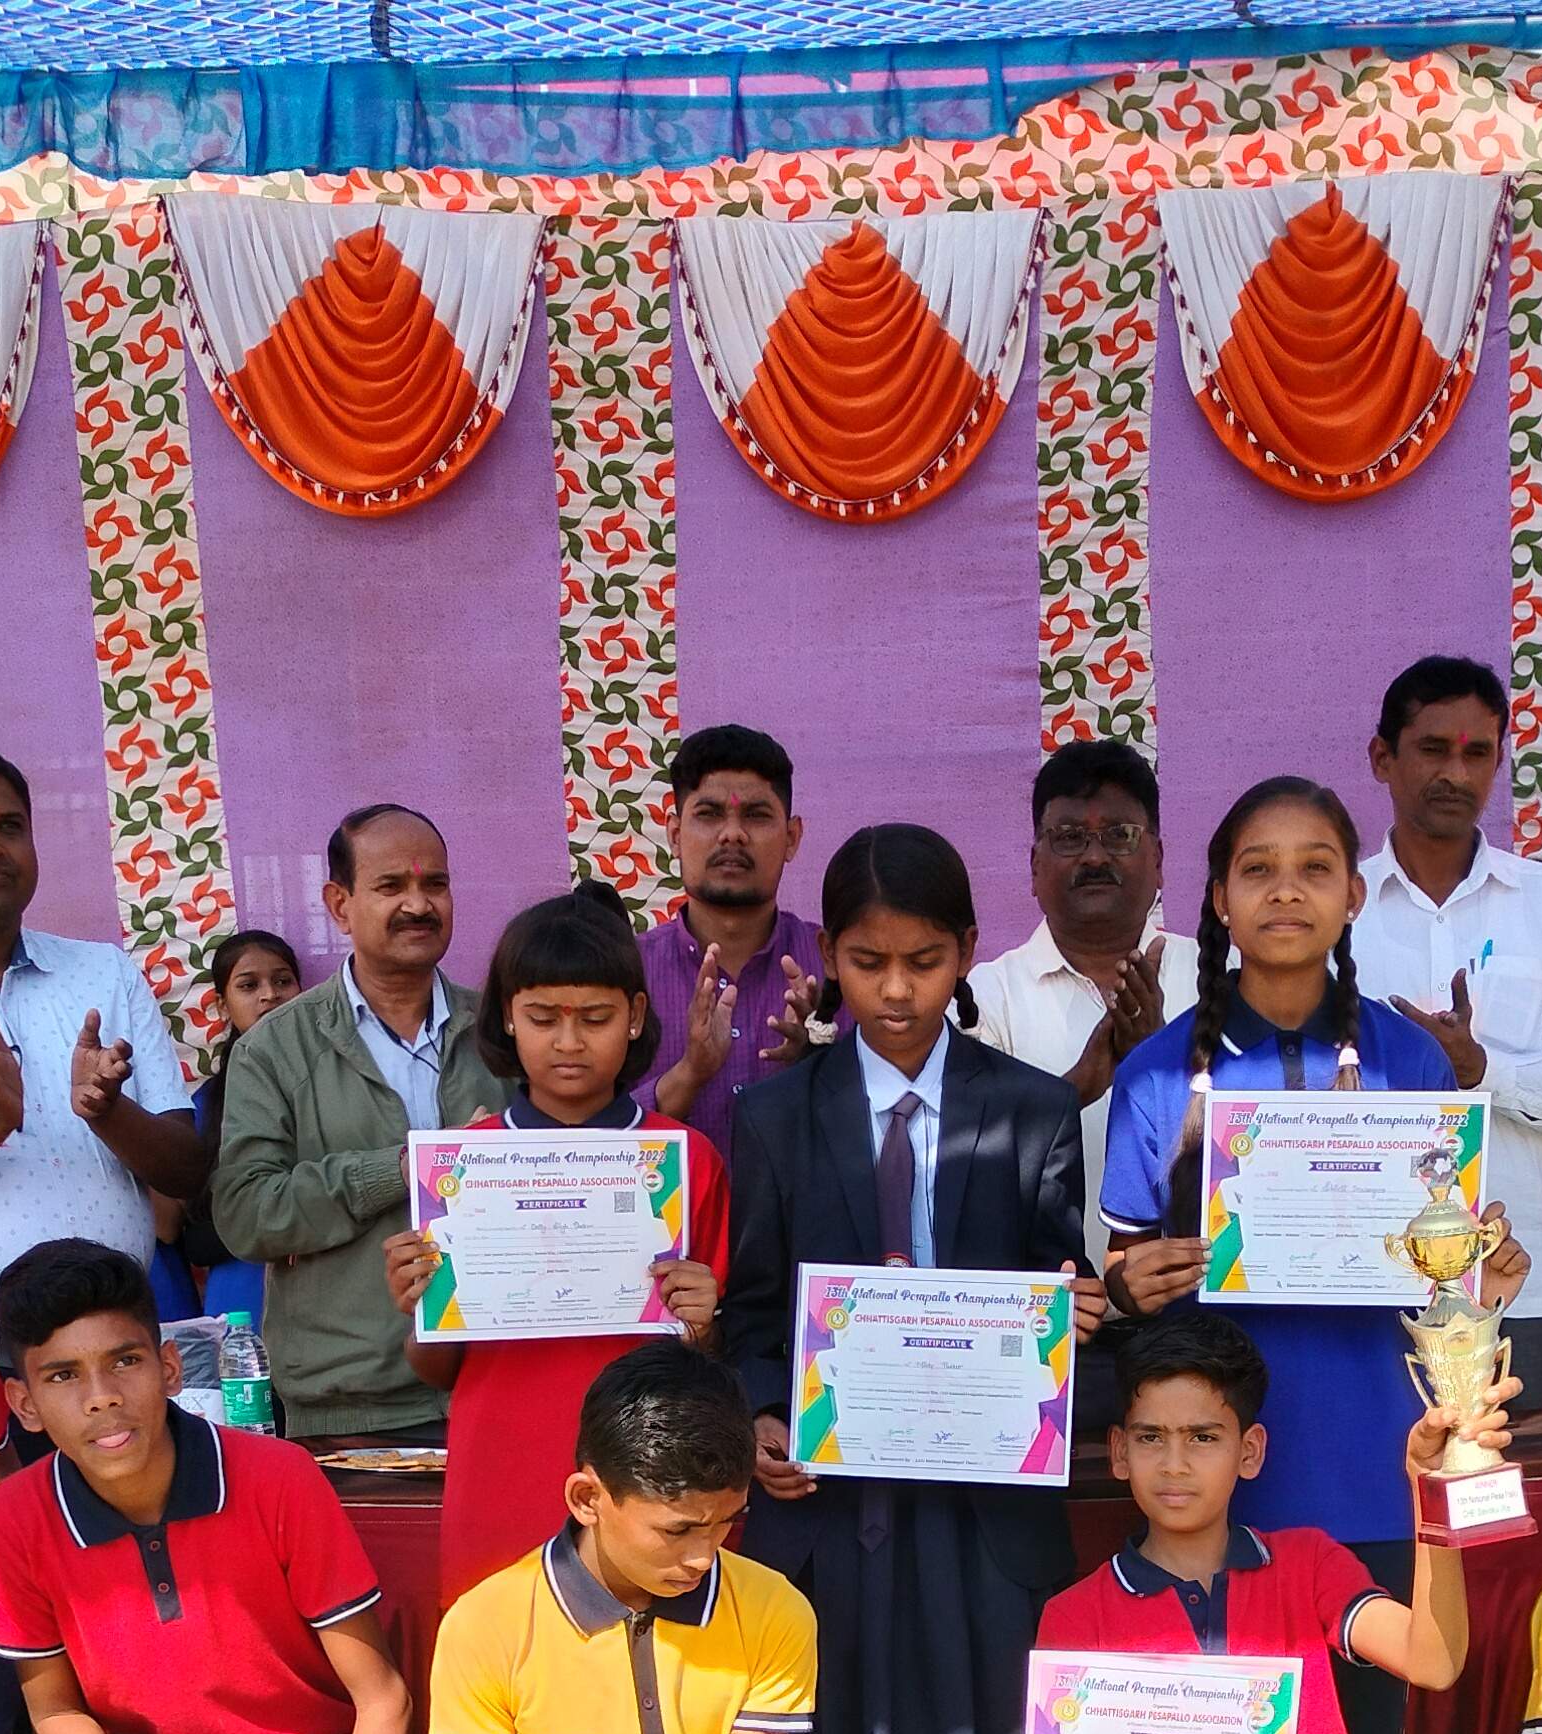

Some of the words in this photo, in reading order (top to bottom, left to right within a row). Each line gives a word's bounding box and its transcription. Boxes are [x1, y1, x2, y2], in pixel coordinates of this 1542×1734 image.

[1229, 1112, 1252, 1125] 13th
[1256, 1113, 1303, 1125] National
[1307, 1113, 1358, 1128] Pesapallo
[1362, 1113, 1435, 1128] Championship
[1439, 1114, 1467, 1126] 2022
[1259, 1139, 1325, 1149] CHHATTISGARH
[1327, 1140, 1374, 1149] PESAPALLO
[1377, 1141, 1435, 1150] ASSOCIATION
[433, 1153, 457, 1166] 13th
[460, 1153, 508, 1165] National
[510, 1152, 561, 1167] Pesapallo
[565, 1150, 635, 1168] Championship
[638, 1150, 667, 1162] 2022
[1315, 1162, 1376, 1171] CERTIFICATE
[465, 1178, 529, 1189] CHHATTISGARH
[532, 1177, 578, 1188] PESAPALLO
[580, 1176, 636, 1187] ASSOCIATION
[522, 1199, 581, 1209] CERTIFICATE
[825, 1287, 848, 1299] 13th
[851, 1287, 898, 1300] National
[900, 1290, 950, 1305] Pesapallo
[954, 1292, 1026, 1309] Championship
[1029, 1295, 1057, 1306] 2022
[854, 1314, 918, 1325] CHHATTISGARH
[921, 1317, 966, 1327] PESAPALLO
[969, 1318, 1025, 1329] ASSOCIATION
[909, 1339, 967, 1349] CERTIFICATE
[1084, 1678, 1128, 1693] National
[1183, 1684, 1245, 1706] Championship
[1085, 1706, 1146, 1720] CHHATTISGARH
[1148, 1711, 1191, 1723] PESAPALLO
[1193, 1714, 1243, 1726] ASSOCIATION
